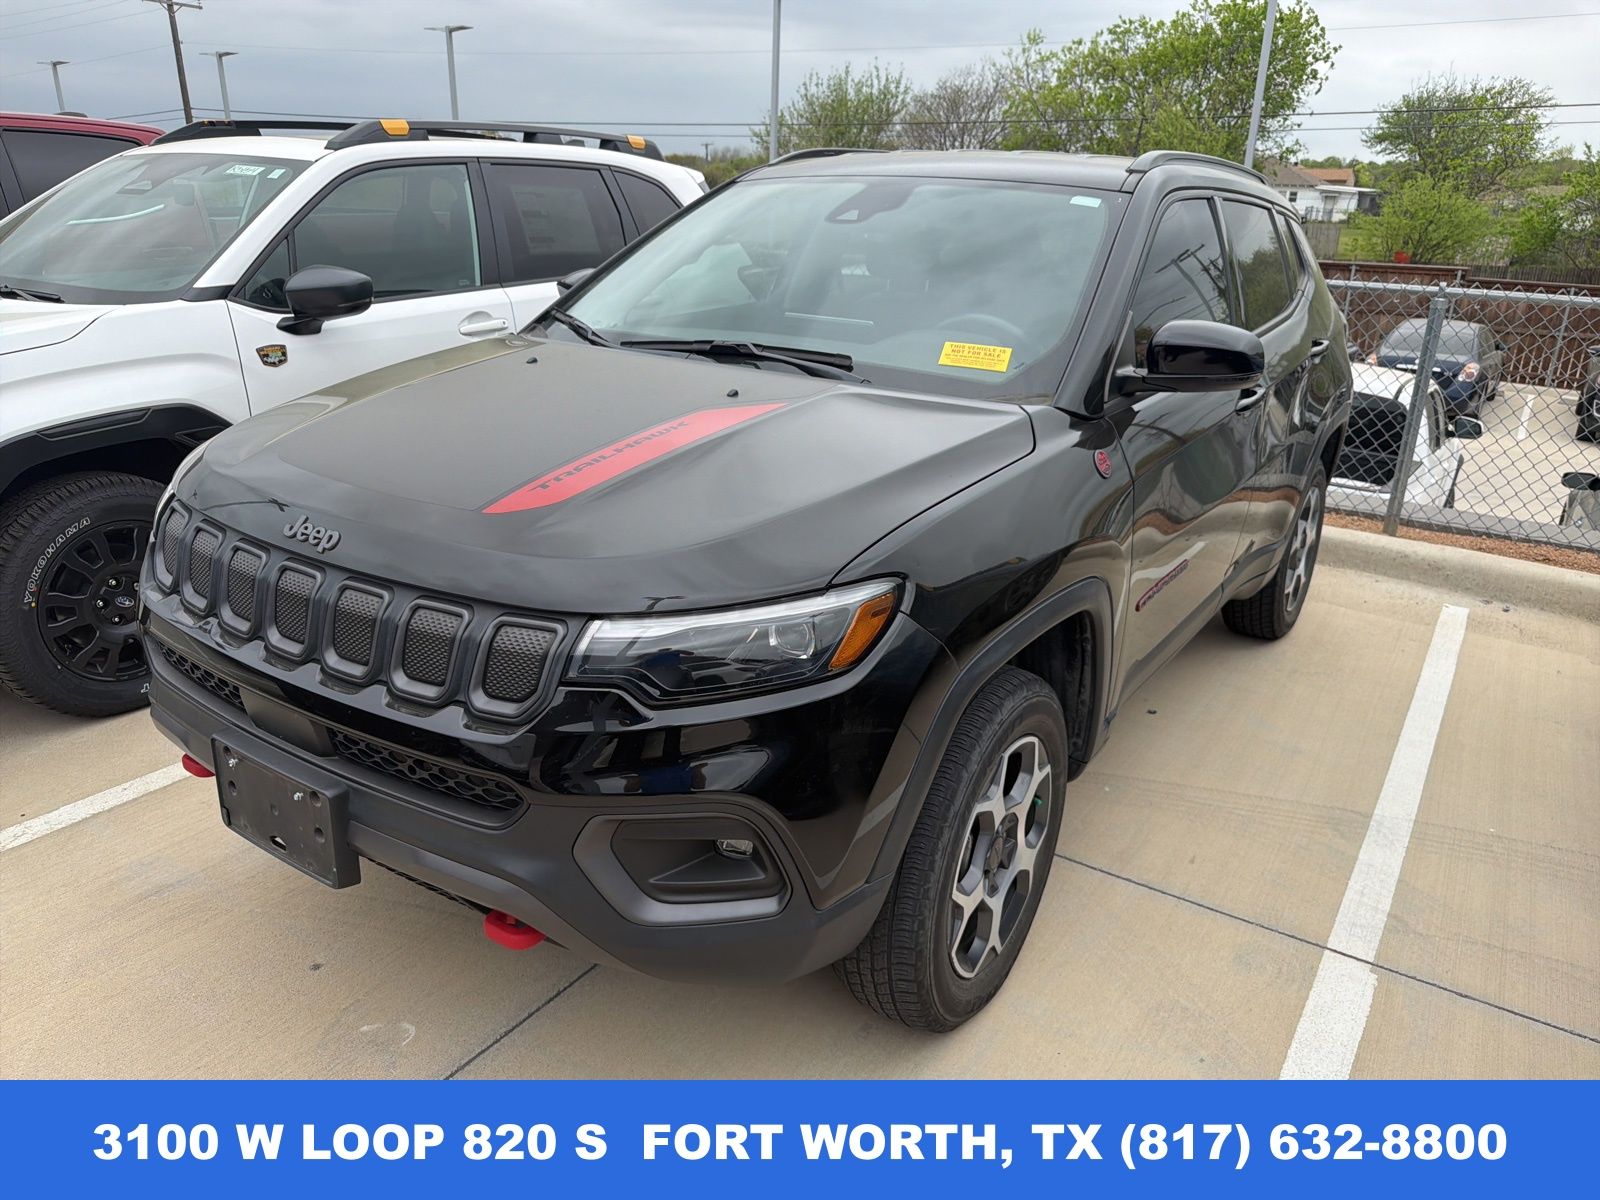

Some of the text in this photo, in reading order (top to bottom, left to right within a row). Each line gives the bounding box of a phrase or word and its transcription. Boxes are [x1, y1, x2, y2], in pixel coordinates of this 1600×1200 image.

[967, 345, 996, 353] VEHICLE
[527, 421, 688, 491] TRAILHAWK
[24, 517, 91, 604] YOKOHAMA
[283, 515, 341, 554] Jeep
